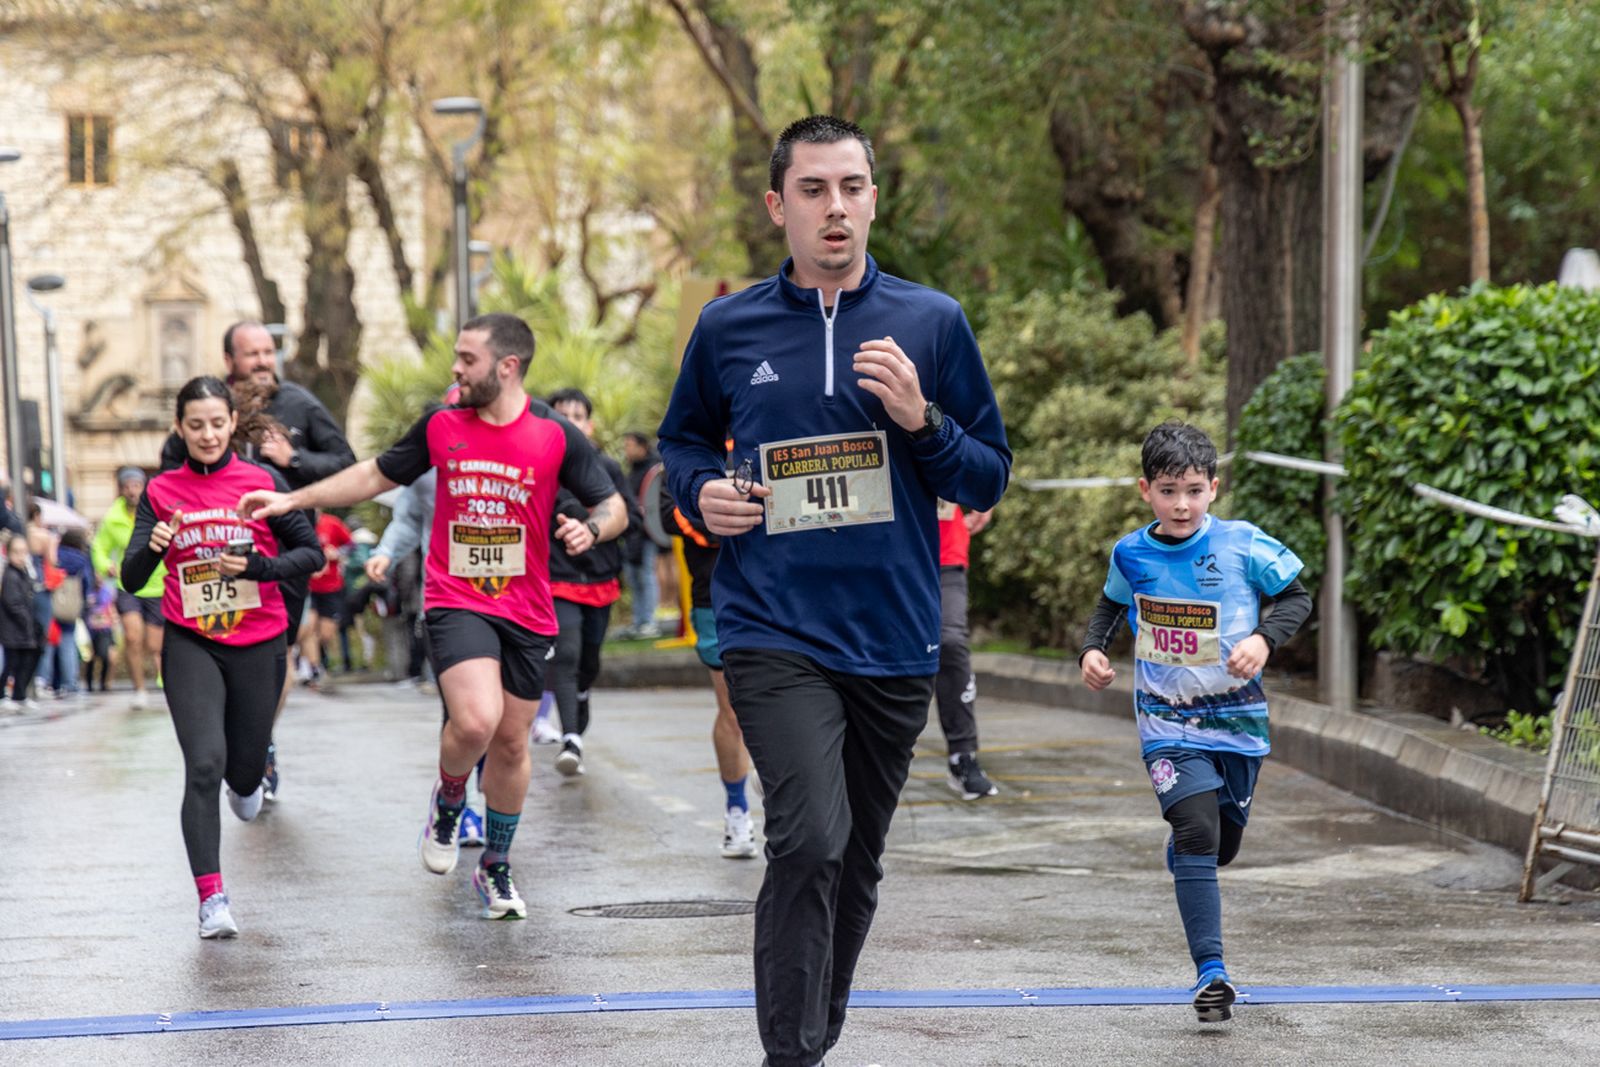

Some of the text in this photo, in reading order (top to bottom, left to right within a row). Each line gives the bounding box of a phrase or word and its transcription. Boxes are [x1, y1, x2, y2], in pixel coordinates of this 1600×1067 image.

[751, 374, 779, 385] adidas
[773, 440, 874, 462] IES San Juan Bosco
[460, 460, 521, 479] CARRERA DE
[771, 453, 880, 477] V CARRERA POPULAR
[448, 477, 478, 496] SAN
[182, 508, 225, 524] CARRERA
[468, 499, 506, 515] 2026
[174, 527, 202, 550] SAN
[468, 547, 504, 566] 544
[202, 580, 238, 602] 975
[1147, 612, 1175, 626] CARRERA
[1177, 616, 1214, 628] POPULAR
[1166, 605, 1185, 615] Juan
[1186, 605, 1211, 616] Bosco
[1151, 627, 1199, 655] 1059
